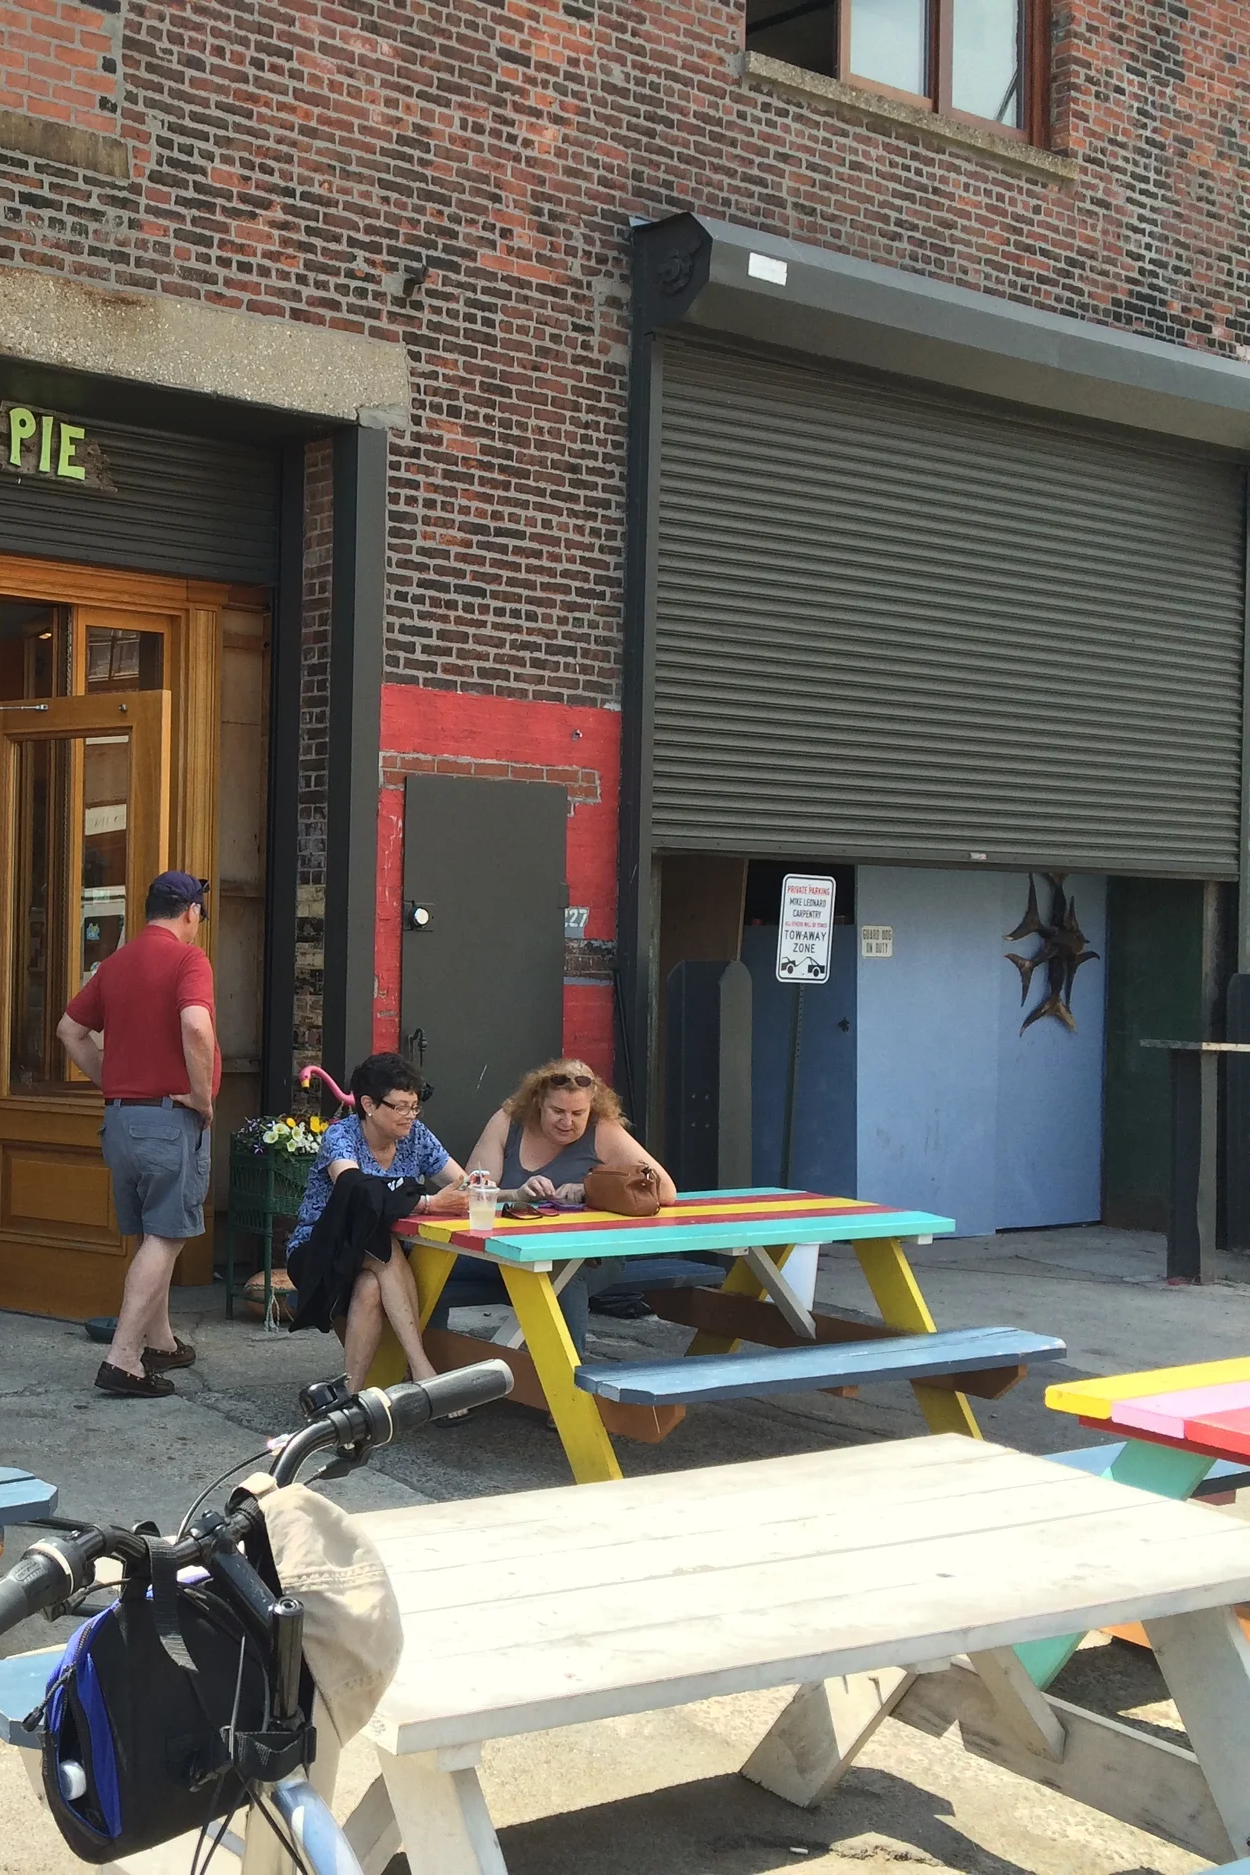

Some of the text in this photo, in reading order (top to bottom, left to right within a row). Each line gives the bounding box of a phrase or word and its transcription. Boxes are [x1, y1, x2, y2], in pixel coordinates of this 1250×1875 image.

[8, 406, 86, 481] PIE
[787, 885, 830, 896] PRIVATE PARKING
[789, 897, 827, 908] MIKE LEONARD
[565, 908, 588, 928] 27
[792, 909, 822, 919] CARPENTRY
[784, 929, 827, 941] TOW-AWAY
[863, 929, 892, 941] GUARD DOG
[792, 942, 816, 953] ZONE
[866, 942, 888, 954] ON DUTY
